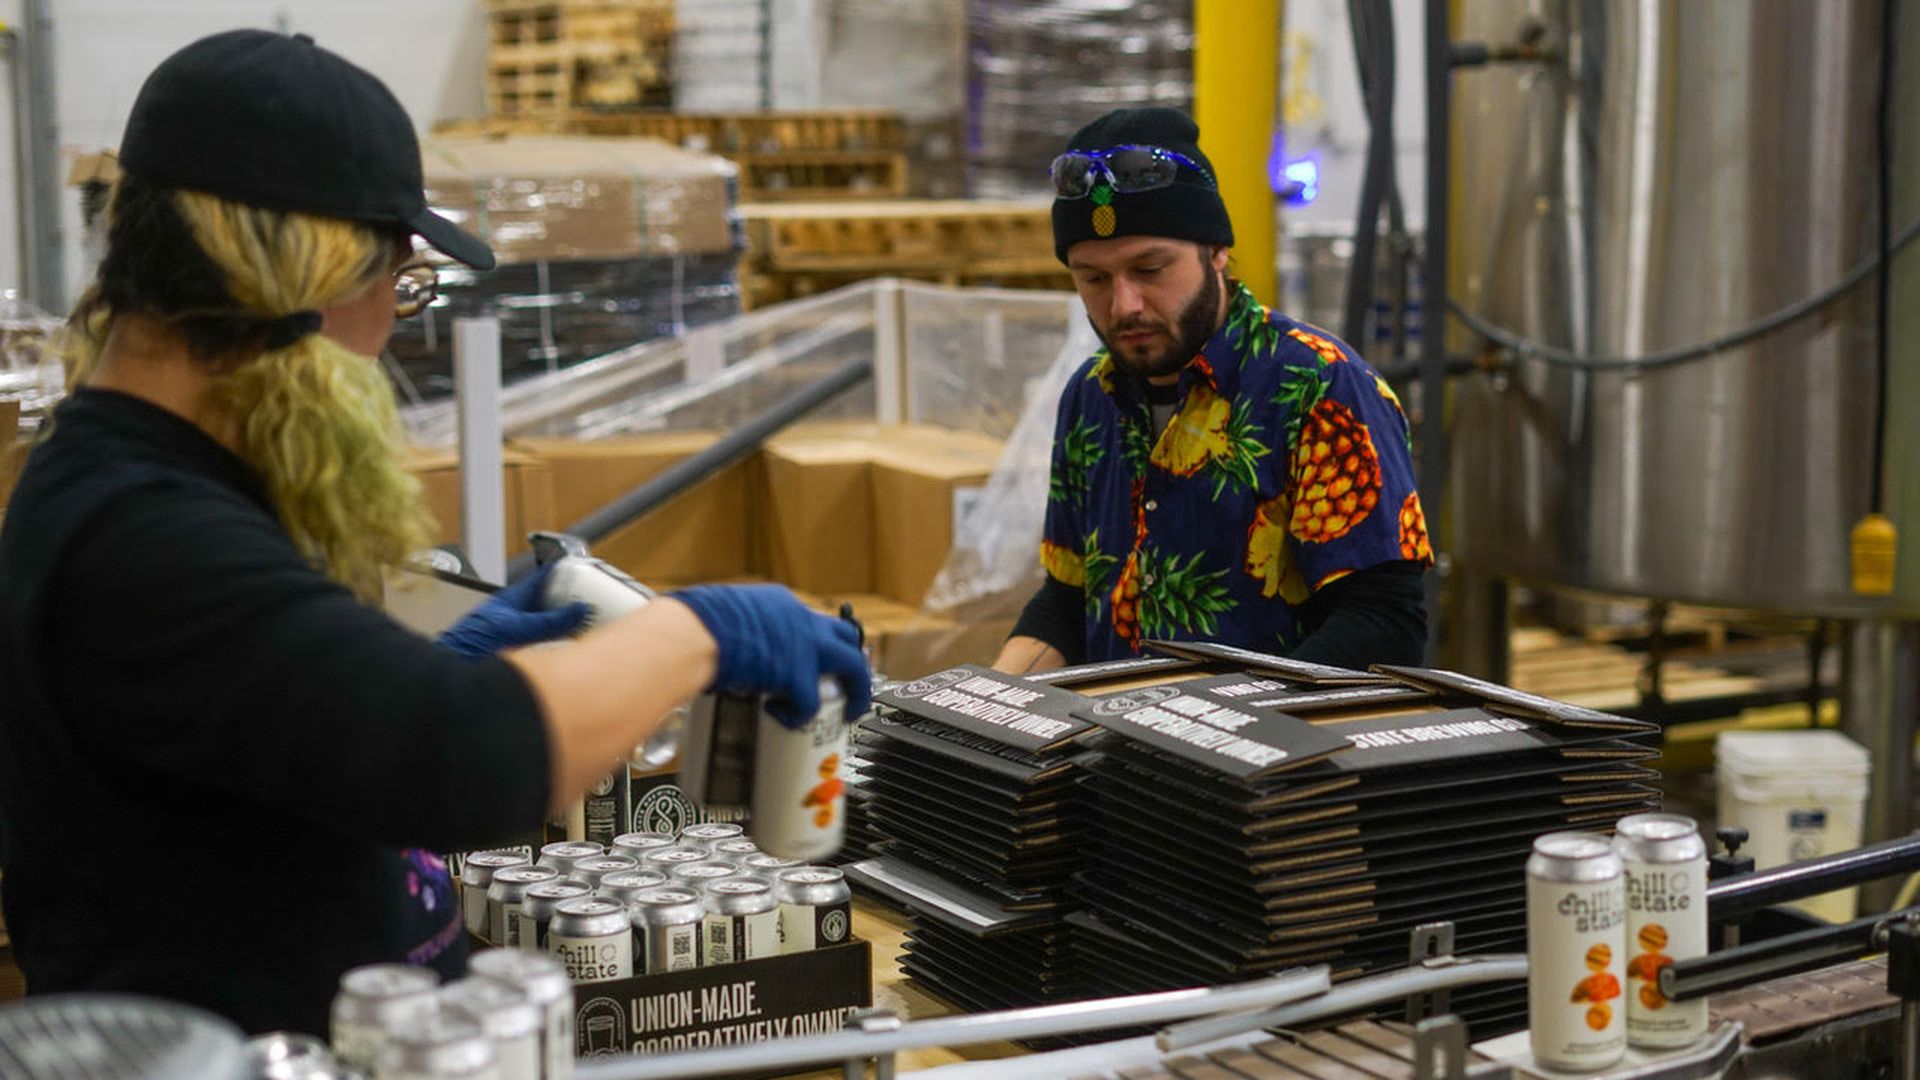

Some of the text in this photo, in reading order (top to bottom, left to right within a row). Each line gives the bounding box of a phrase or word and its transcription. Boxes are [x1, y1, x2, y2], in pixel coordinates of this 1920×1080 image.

[1624, 870, 1667, 893] hill
[1629, 894, 1691, 912] state
[565, 964, 618, 980] state
[631, 981, 762, 1034] UNION-MADE.
[791, 1006, 859, 1037] OWNE
